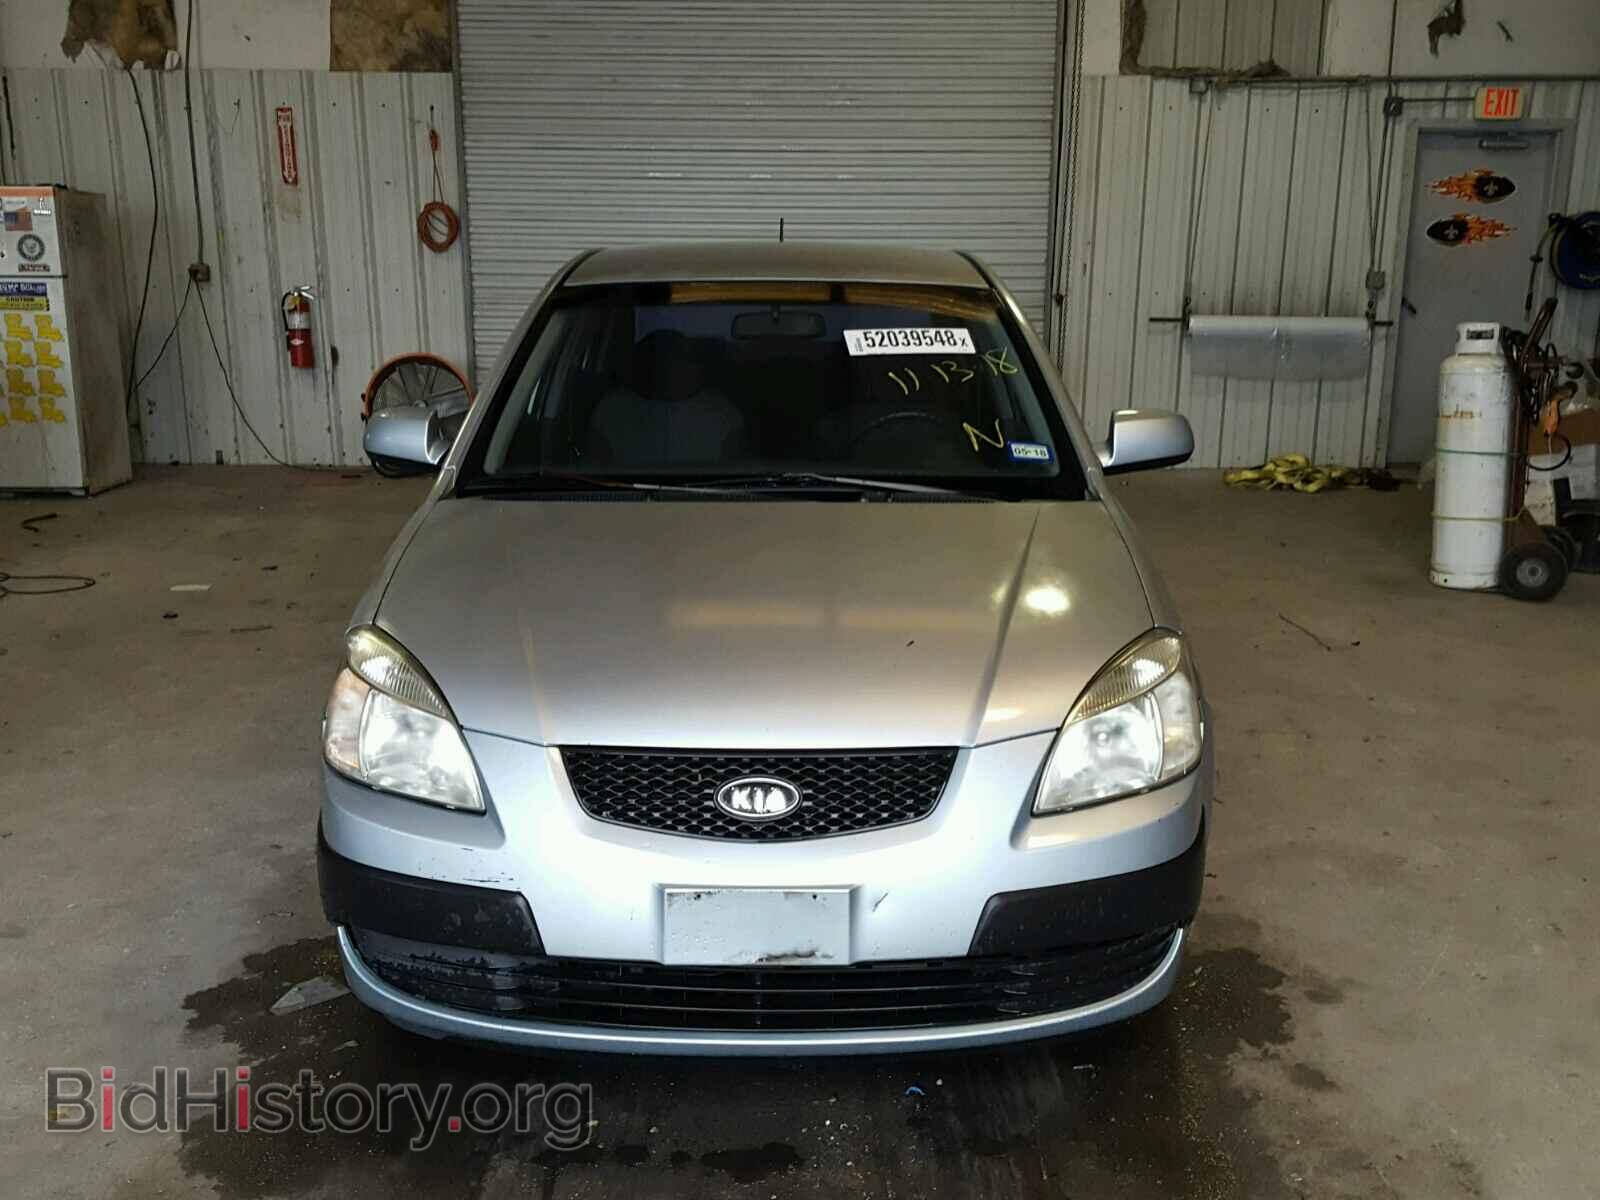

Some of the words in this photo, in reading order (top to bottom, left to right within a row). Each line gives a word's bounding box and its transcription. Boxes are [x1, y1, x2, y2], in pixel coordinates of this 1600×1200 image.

[1483, 87, 1520, 117] EXIT
[863, 329, 958, 348] 52039548
[888, 368, 919, 395] 11
[930, 361, 975, 383] 13
[979, 346, 1018, 376] 18
[963, 418, 1004, 451] N
[731, 786, 787, 813] KIA
